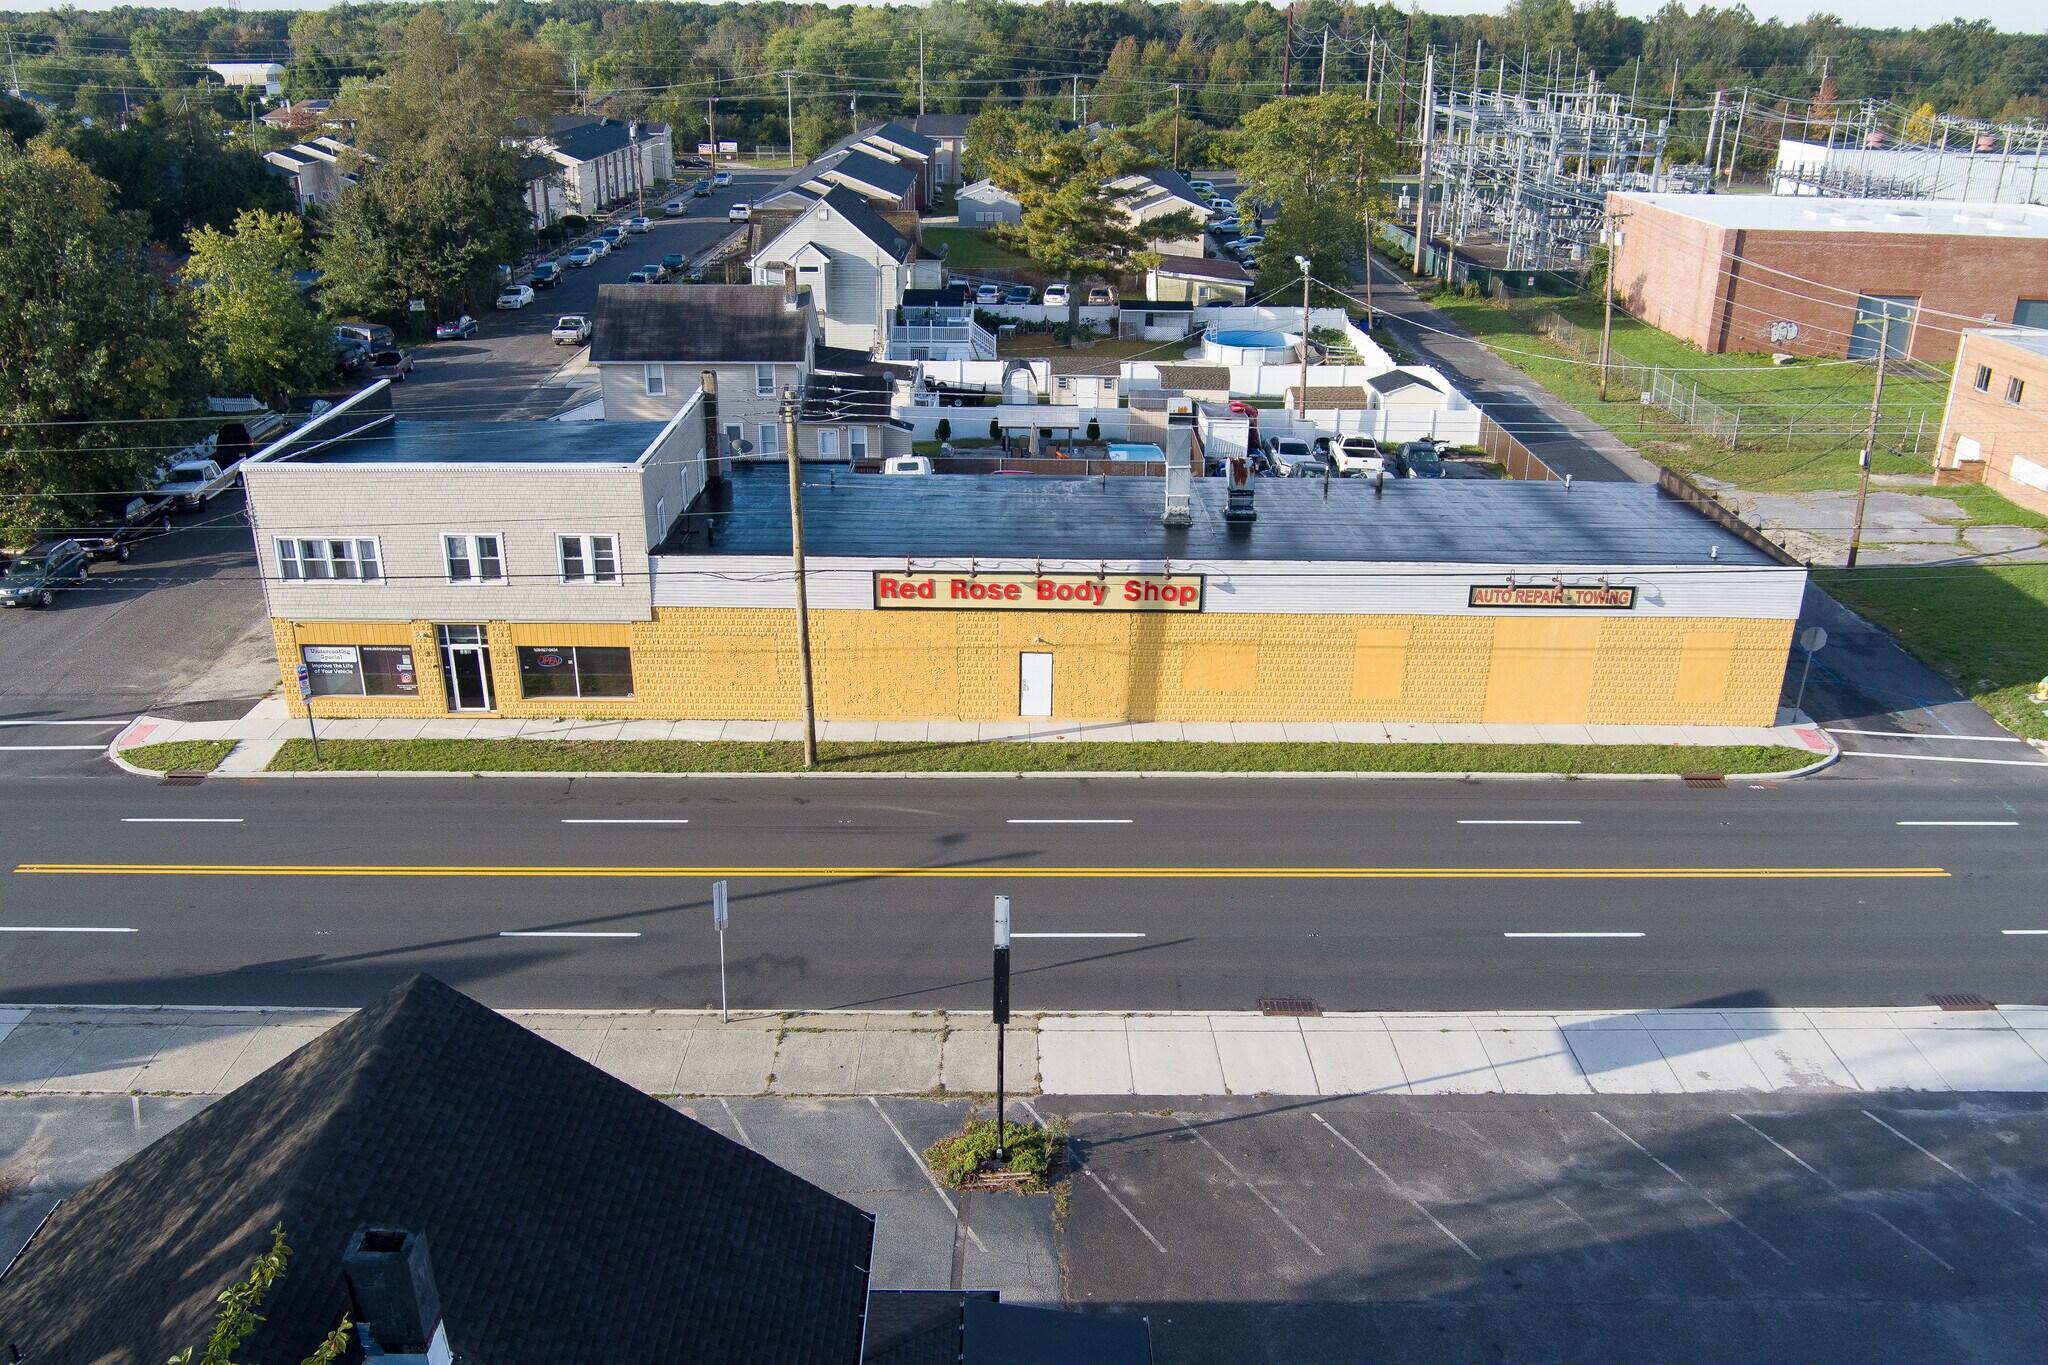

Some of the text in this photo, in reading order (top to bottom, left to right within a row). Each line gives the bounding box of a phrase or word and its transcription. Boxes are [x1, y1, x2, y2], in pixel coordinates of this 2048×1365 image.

[880, 578, 1196, 606] Red Rose Body Shop
[1473, 589, 1512, 603] AUTO
[1515, 590, 1564, 603] REPAIR
[1576, 591, 1629, 604] TOWING
[538, 655, 561, 665] OPEN
